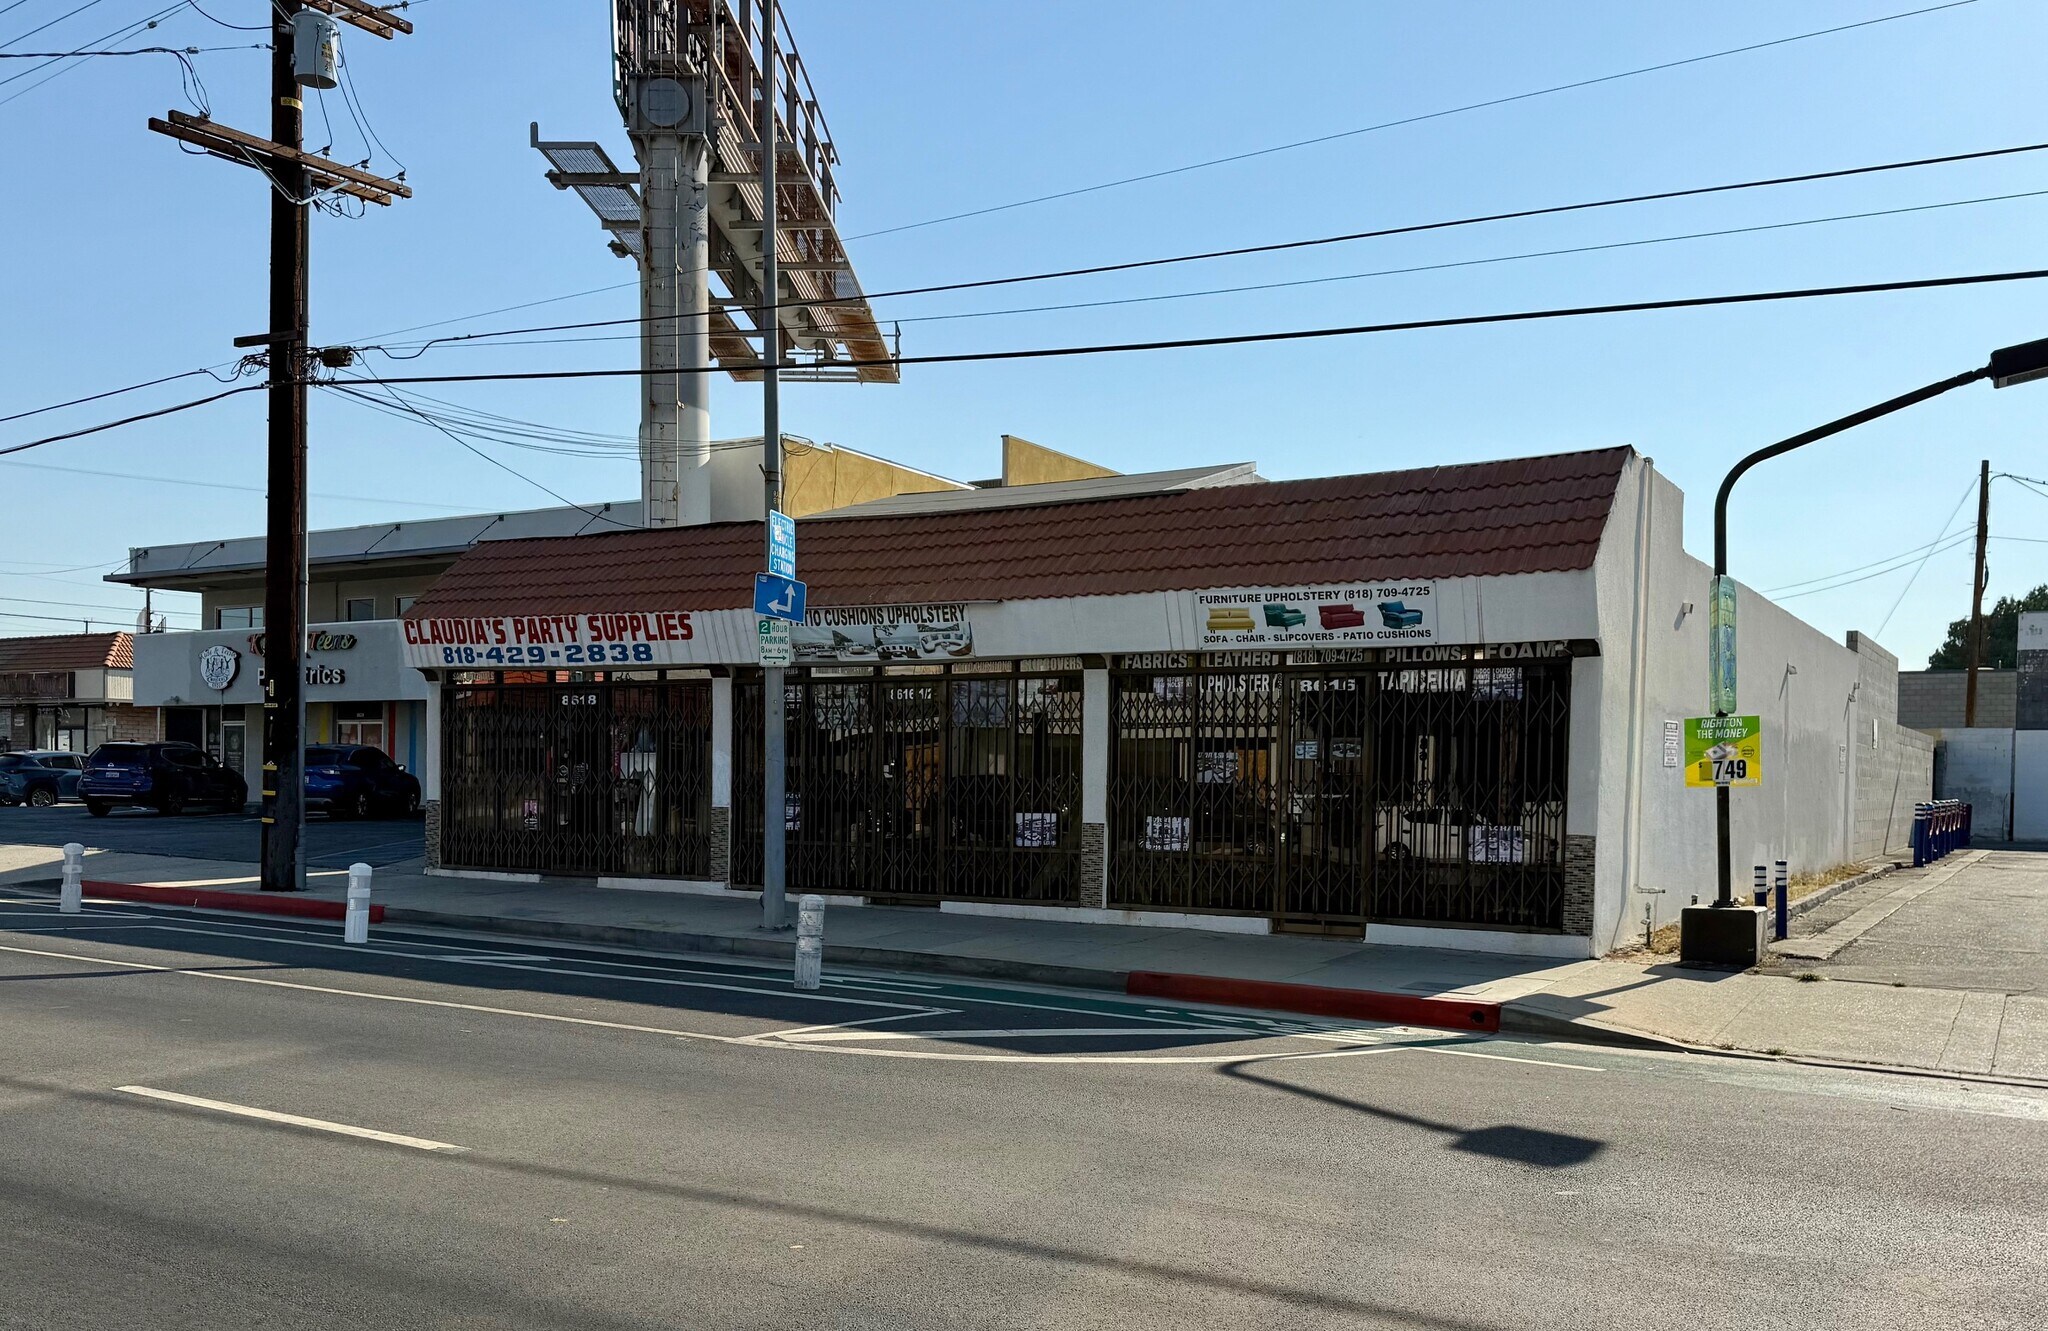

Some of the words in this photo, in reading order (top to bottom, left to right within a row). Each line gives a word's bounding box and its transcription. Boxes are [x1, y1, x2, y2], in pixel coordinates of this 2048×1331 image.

[773, 557, 793, 576] STATION
[1200, 594, 1261, 605] FURNITURE
[1265, 590, 1340, 603] UPHOLSTERY
[1344, 588, 1373, 601] (818)
[1377, 586, 1430, 599] 709-4725
[824, 607, 884, 626] CUSHIONS
[887, 603, 966, 625] UPHOLSTERY
[404, 618, 506, 645] CLAUDIA'S
[513, 616, 578, 644] PARTY
[588, 613, 694, 643] SUPPLIES
[761, 622, 768, 632] 2
[772, 625, 788, 633] HOUR
[761, 635, 788, 645] PARKING
[1203, 635, 1228, 644] SOFA
[1236, 633, 1266, 643] CHAIR
[1273, 632, 1334, 642] SLIPCOVERS
[1343, 631, 1373, 641] PATIO
[1377, 629, 1432, 639] CUSHIONS
[443, 643, 653, 664] 818-429-2838
[1293, 649, 1317, 663] (818)
[1320, 648, 1363, 662] 709-4725
[1386, 646, 1461, 663] PILLOWS
[1484, 643, 1556, 659] FOAM
[1125, 653, 1188, 669] FABRICS
[1206, 651, 1272, 668] LEATHER
[561, 694, 597, 705] 8618
[1701, 718, 1729, 729] RIGHT
[1729, 717, 1743, 727] ON
[1697, 729, 1713, 739] THE
[1715, 728, 1748, 739] MONEY
